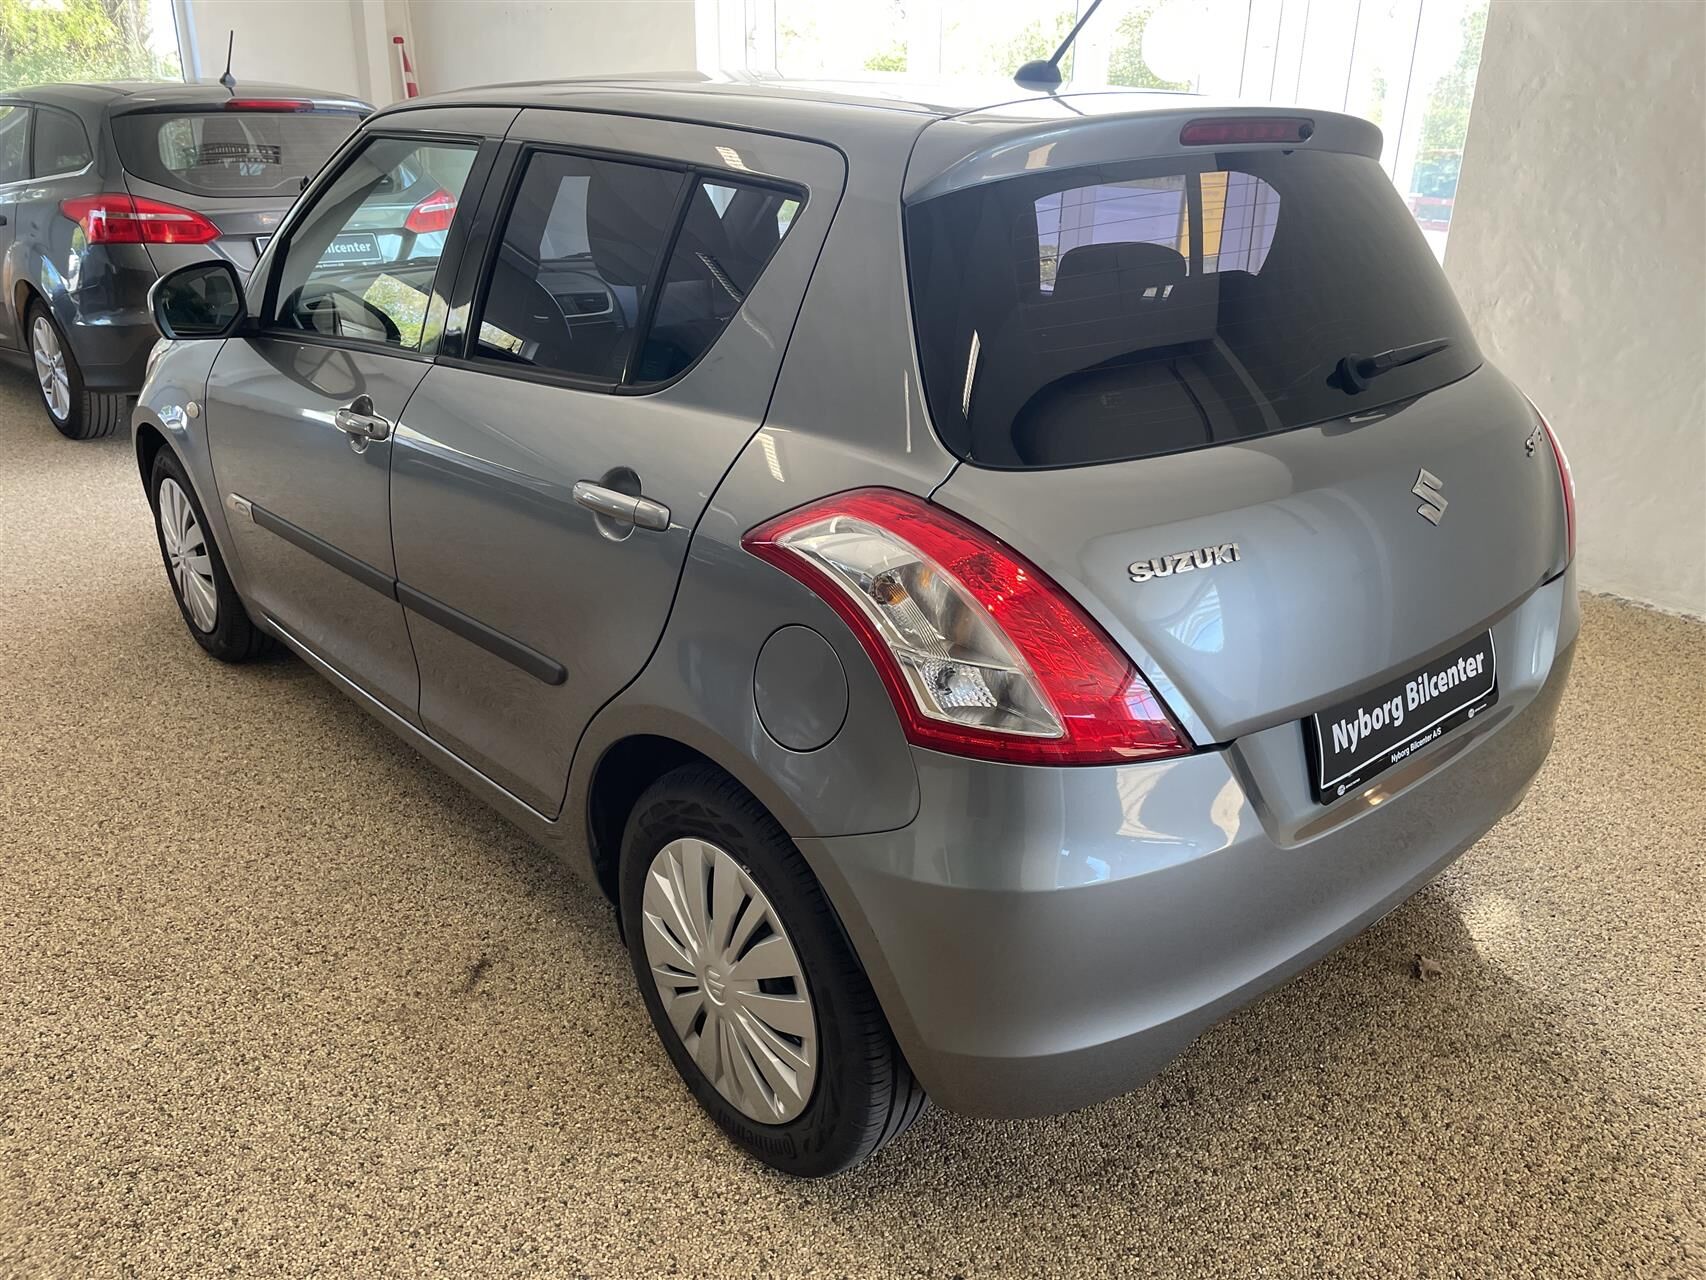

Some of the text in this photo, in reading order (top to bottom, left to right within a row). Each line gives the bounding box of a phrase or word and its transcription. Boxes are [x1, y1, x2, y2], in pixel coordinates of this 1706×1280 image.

[1128, 542, 1241, 583] SUZUKI
[1331, 652, 1485, 753] Nyborg Bilcenter
[1391, 747, 1410, 763] Nyborg
[1410, 733, 1433, 752] Bilcenter
